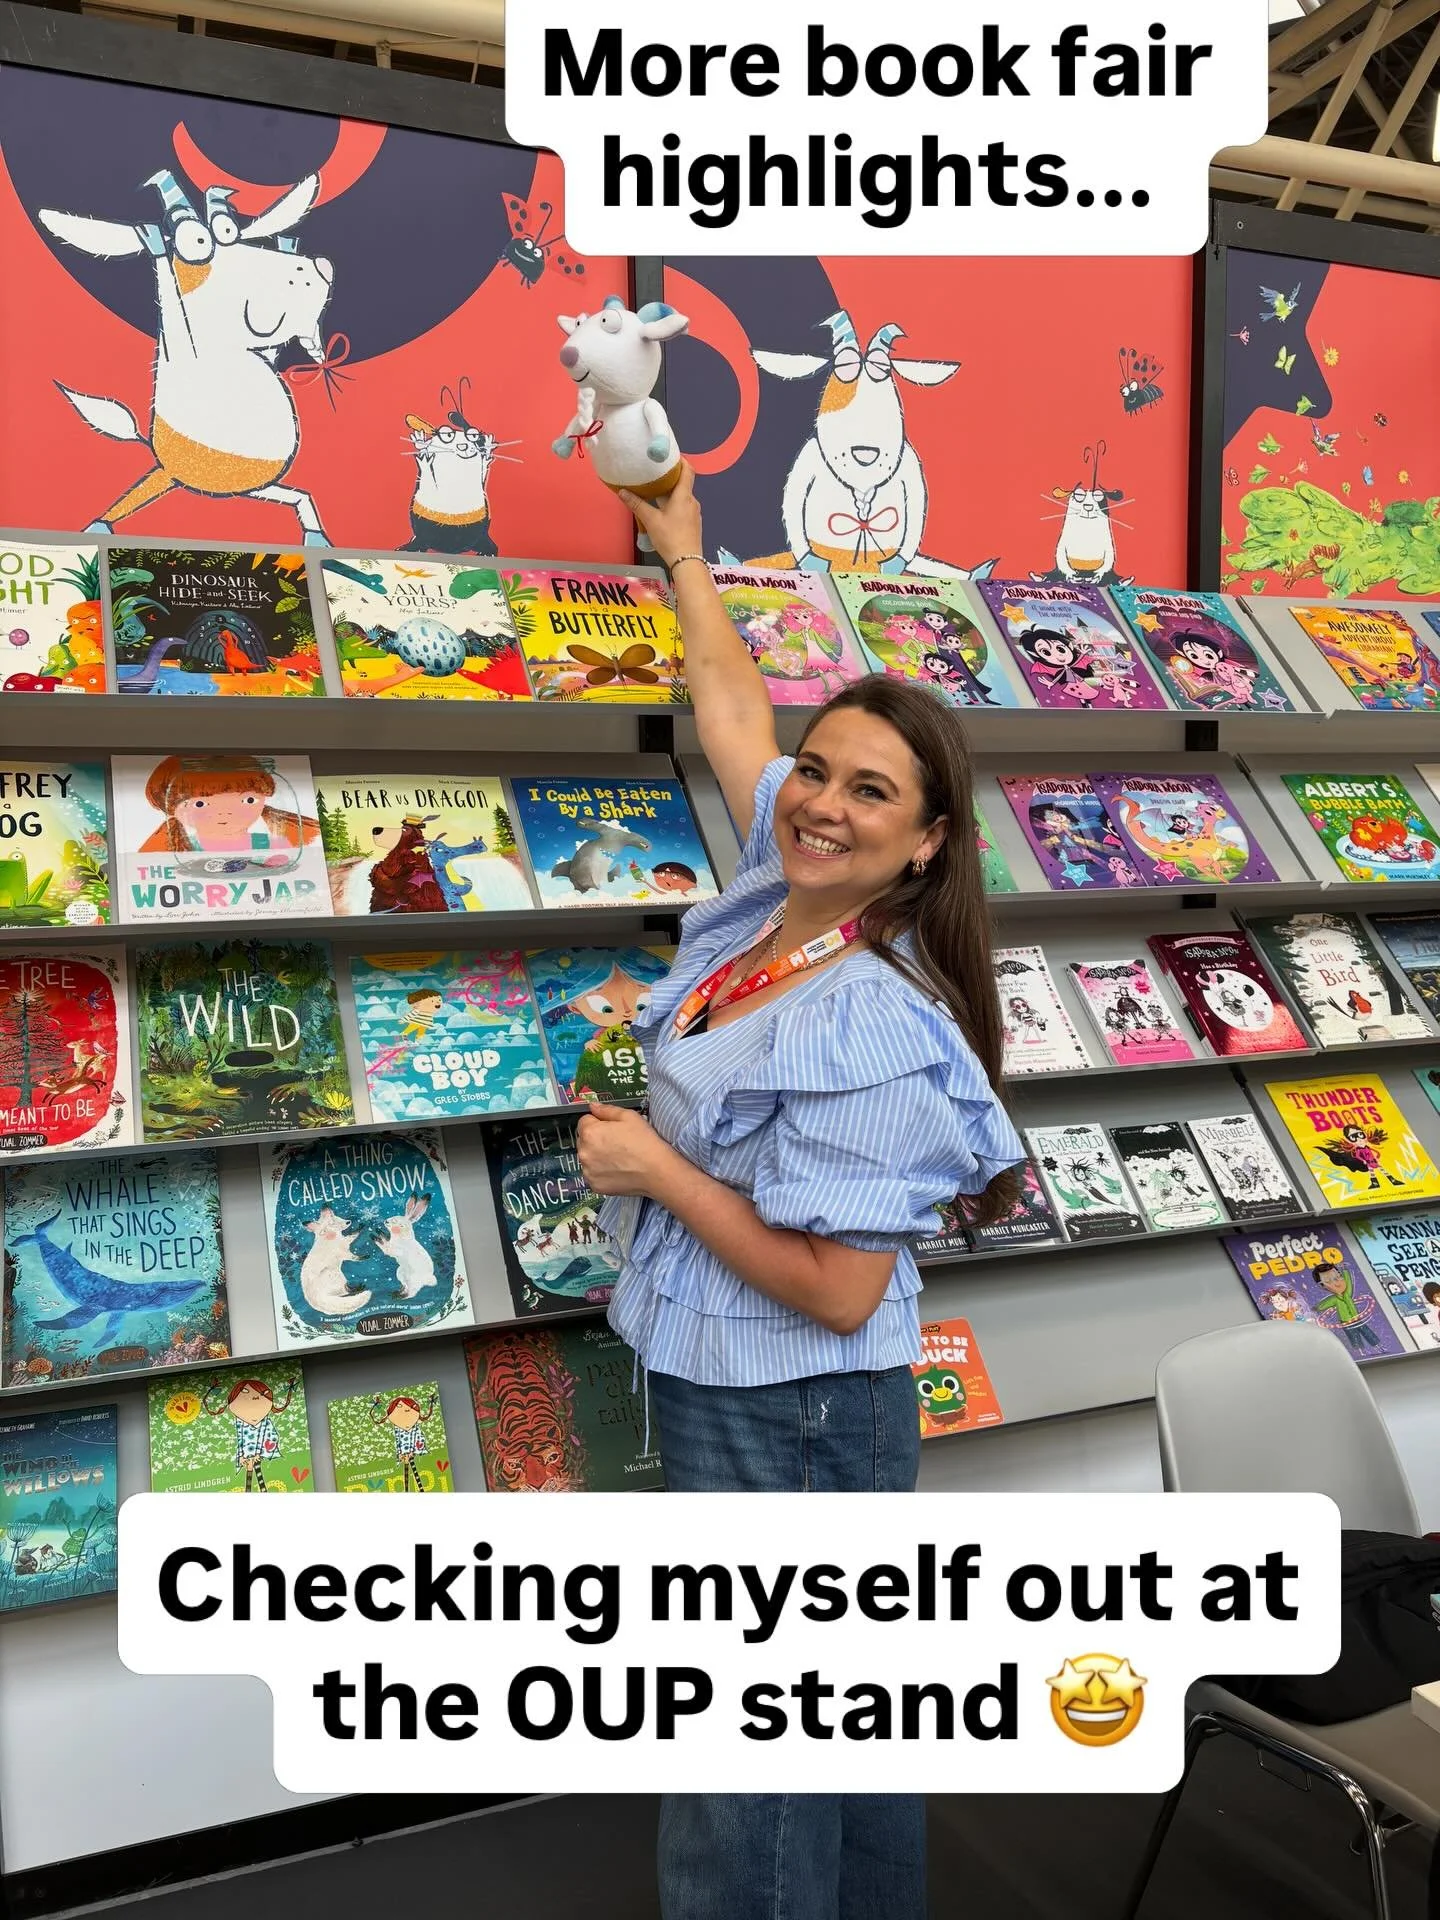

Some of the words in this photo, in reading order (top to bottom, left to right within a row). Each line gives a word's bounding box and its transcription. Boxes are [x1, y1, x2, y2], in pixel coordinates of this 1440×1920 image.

[0, 552, 54, 577] OD
[171, 574, 259, 588] DINOSAUR
[394, 583, 426, 596] AM
[437, 585, 444, 597] I
[713, 573, 760, 587] ISADORA
[760, 577, 798, 591] MOON
[860, 581, 904, 595] ISADORA
[904, 584, 940, 597] MOON
[384, 595, 458, 609] YOURS?
[551, 578, 638, 607] FRANK
[1005, 587, 1046, 600] ISADORA
[1046, 590, 1081, 601] MOON
[1174, 598, 1205, 610] MOON
[548, 611, 658, 638] BUTTERFLY
[1327, 620, 1392, 635] AWESOMELY
[1342, 634, 1397, 645] ADVENTUROUS
[0, 772, 73, 798] FREY
[528, 788, 542, 801] I
[546, 787, 592, 803] Could
[593, 787, 615, 800] Be
[617, 786, 672, 801] Eaten
[1036, 782, 1078, 795] ISADORA
[1123, 780, 1163, 793] ISADORA
[1161, 782, 1194, 794] MOON
[1305, 780, 1397, 798] ALBERT'S
[341, 789, 392, 808] BEAR
[395, 794, 409, 806] vs
[414, 789, 489, 808] DRAGON
[1309, 798, 1365, 810] BUBBLE
[1365, 798, 1407, 810] BATH
[559, 803, 579, 819] By
[583, 805, 594, 817] a
[599, 800, 658, 819] Shark
[0, 811, 43, 838] OG
[137, 864, 177, 880] THE
[131, 880, 248, 909] WORRY
[252, 878, 319, 905] JAR
[1309, 938, 1329, 946] One
[1310, 951, 1345, 964] Little
[10, 961, 77, 991] TREE
[217, 967, 264, 1002] THE
[1318, 967, 1361, 987] Bird
[179, 992, 300, 1051] WILD
[412, 1048, 501, 1074] CLOUD
[430, 1068, 489, 1091] BOY
[608, 1069, 635, 1077] AND
[610, 1076, 635, 1084] THE
[434, 1095, 459, 1105] GREG
[460, 1091, 491, 1102] STOBBS
[1285, 1087, 1382, 1110] THUNDER
[0, 1106, 47, 1127] MEANT
[51, 1103, 71, 1122] TO
[76, 1098, 96, 1118] BE
[1306, 1106, 1384, 1132] BOOTS
[0, 1138, 16, 1148] UVAL
[19, 1134, 45, 1147] ZOMMER
[510, 1128, 549, 1157] THE
[555, 1125, 579, 1150] LI
[1197, 1123, 1257, 1144] MIRABELLE
[1037, 1135, 1104, 1154] EMERALD
[324, 1149, 336, 1171] A
[339, 1142, 394, 1167] THING
[99, 1158, 125, 1175] THE
[65, 1173, 160, 1212] WHALE
[288, 1172, 354, 1208] CALLED
[360, 1163, 428, 1201] SNOW
[571, 1188, 592, 1201] THE
[506, 1178, 571, 1218] DANCE
[575, 1177, 586, 1188] IN
[68, 1214, 107, 1235] THAT
[110, 1207, 177, 1238] SINGS
[980, 1226, 1010, 1237] HARRIET
[1011, 1222, 1051, 1234] MUNCASTER
[916, 1238, 947, 1251] HARRIET
[1248, 1231, 1323, 1262] Perfect
[1387, 1242, 1429, 1262] SEE
[1430, 1240, 1440, 1253] A
[85, 1238, 101, 1260] IN
[104, 1244, 133, 1266] THE
[140, 1236, 205, 1273] DEEP
[1248, 1247, 1344, 1280] PEDRO
[1394, 1258, 1440, 1282] PENG
[360, 1319, 381, 1333] YUVAL
[383, 1315, 409, 1330] ZOMMER
[597, 1340, 622, 1349] Animal
[931, 1336, 950, 1346] TO
[952, 1335, 969, 1347] BE
[918, 1348, 969, 1365] DUCK
[586, 1359, 632, 1387] paw
[2, 1456, 58, 1477] WIND
[347, 1473, 367, 1482] ASTRID
[367, 1467, 394, 1477] LINDGREN
[624, 1460, 654, 1474] Michael
[2, 1465, 104, 1497] WILLOWS
[164, 1483, 191, 1493] ASTRID
[194, 1476, 231, 1489] LINDGREN
